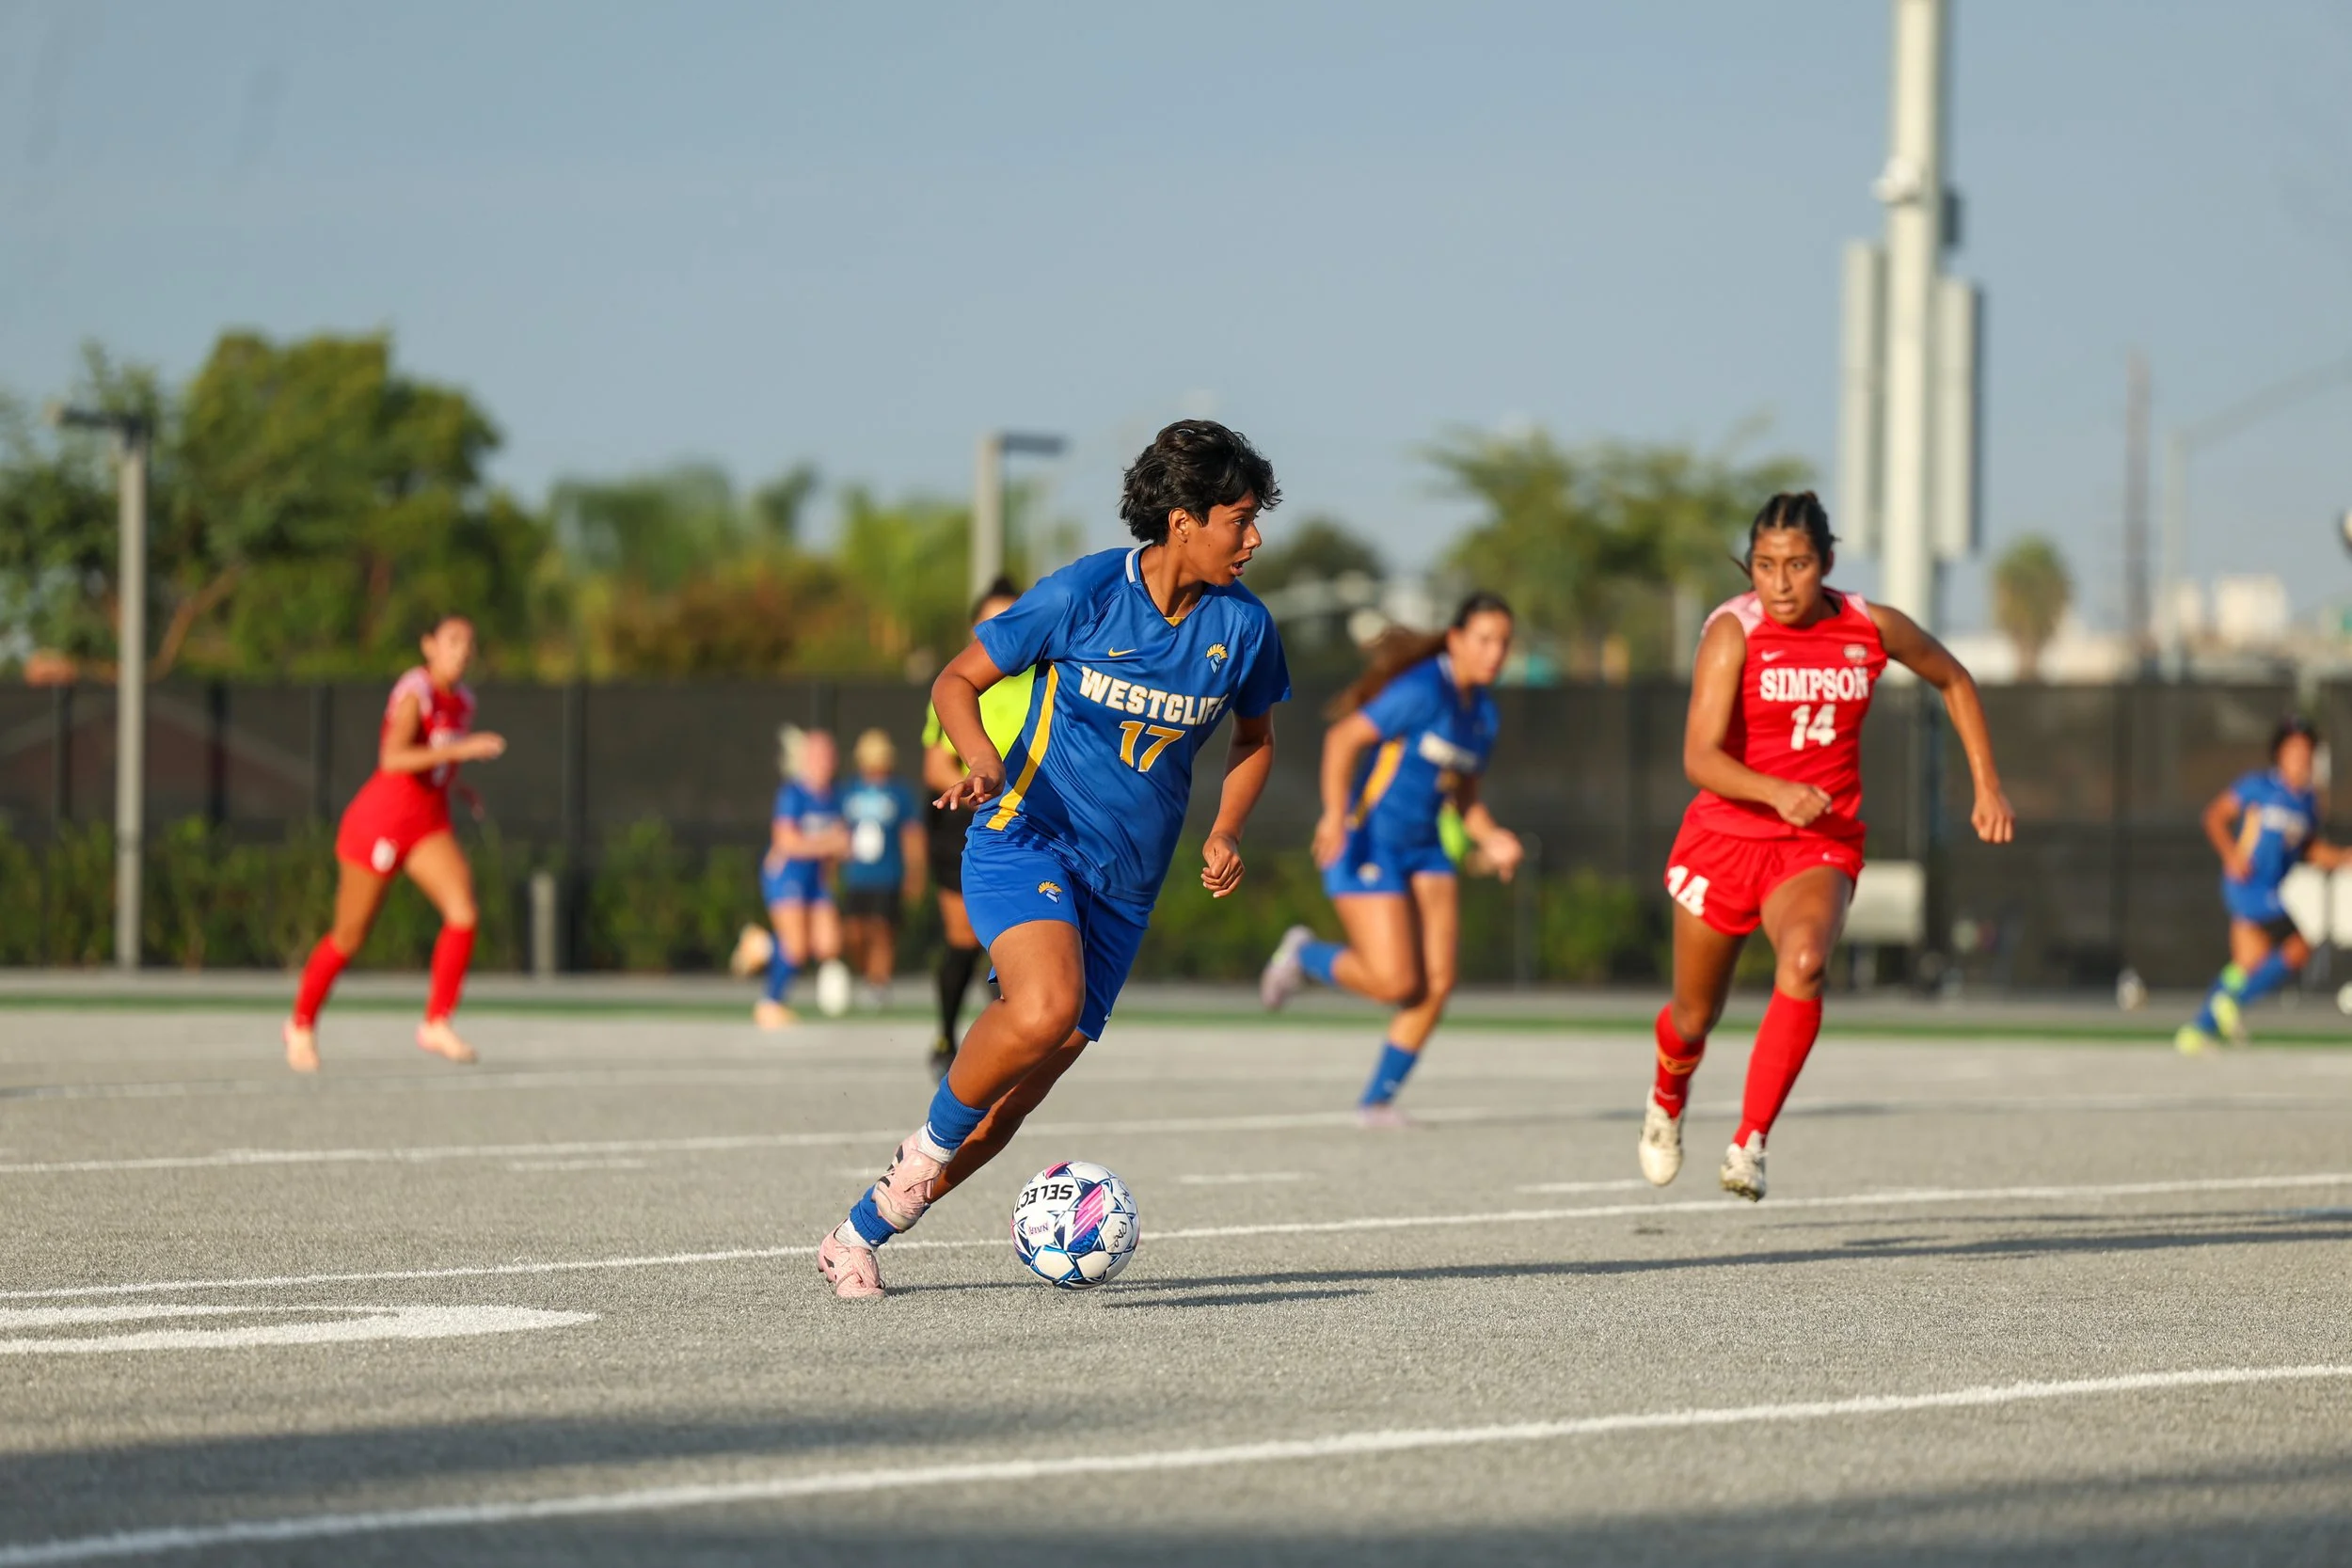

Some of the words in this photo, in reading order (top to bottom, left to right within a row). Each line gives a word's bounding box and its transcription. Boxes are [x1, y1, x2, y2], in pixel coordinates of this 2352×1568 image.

[1079, 666, 1230, 725] WESTCLIFF
[1759, 666, 1870, 703] SIMPSON
[1119, 720, 1185, 772] 17
[1790, 704, 1837, 752] 14
[1666, 864, 1710, 917] 14
